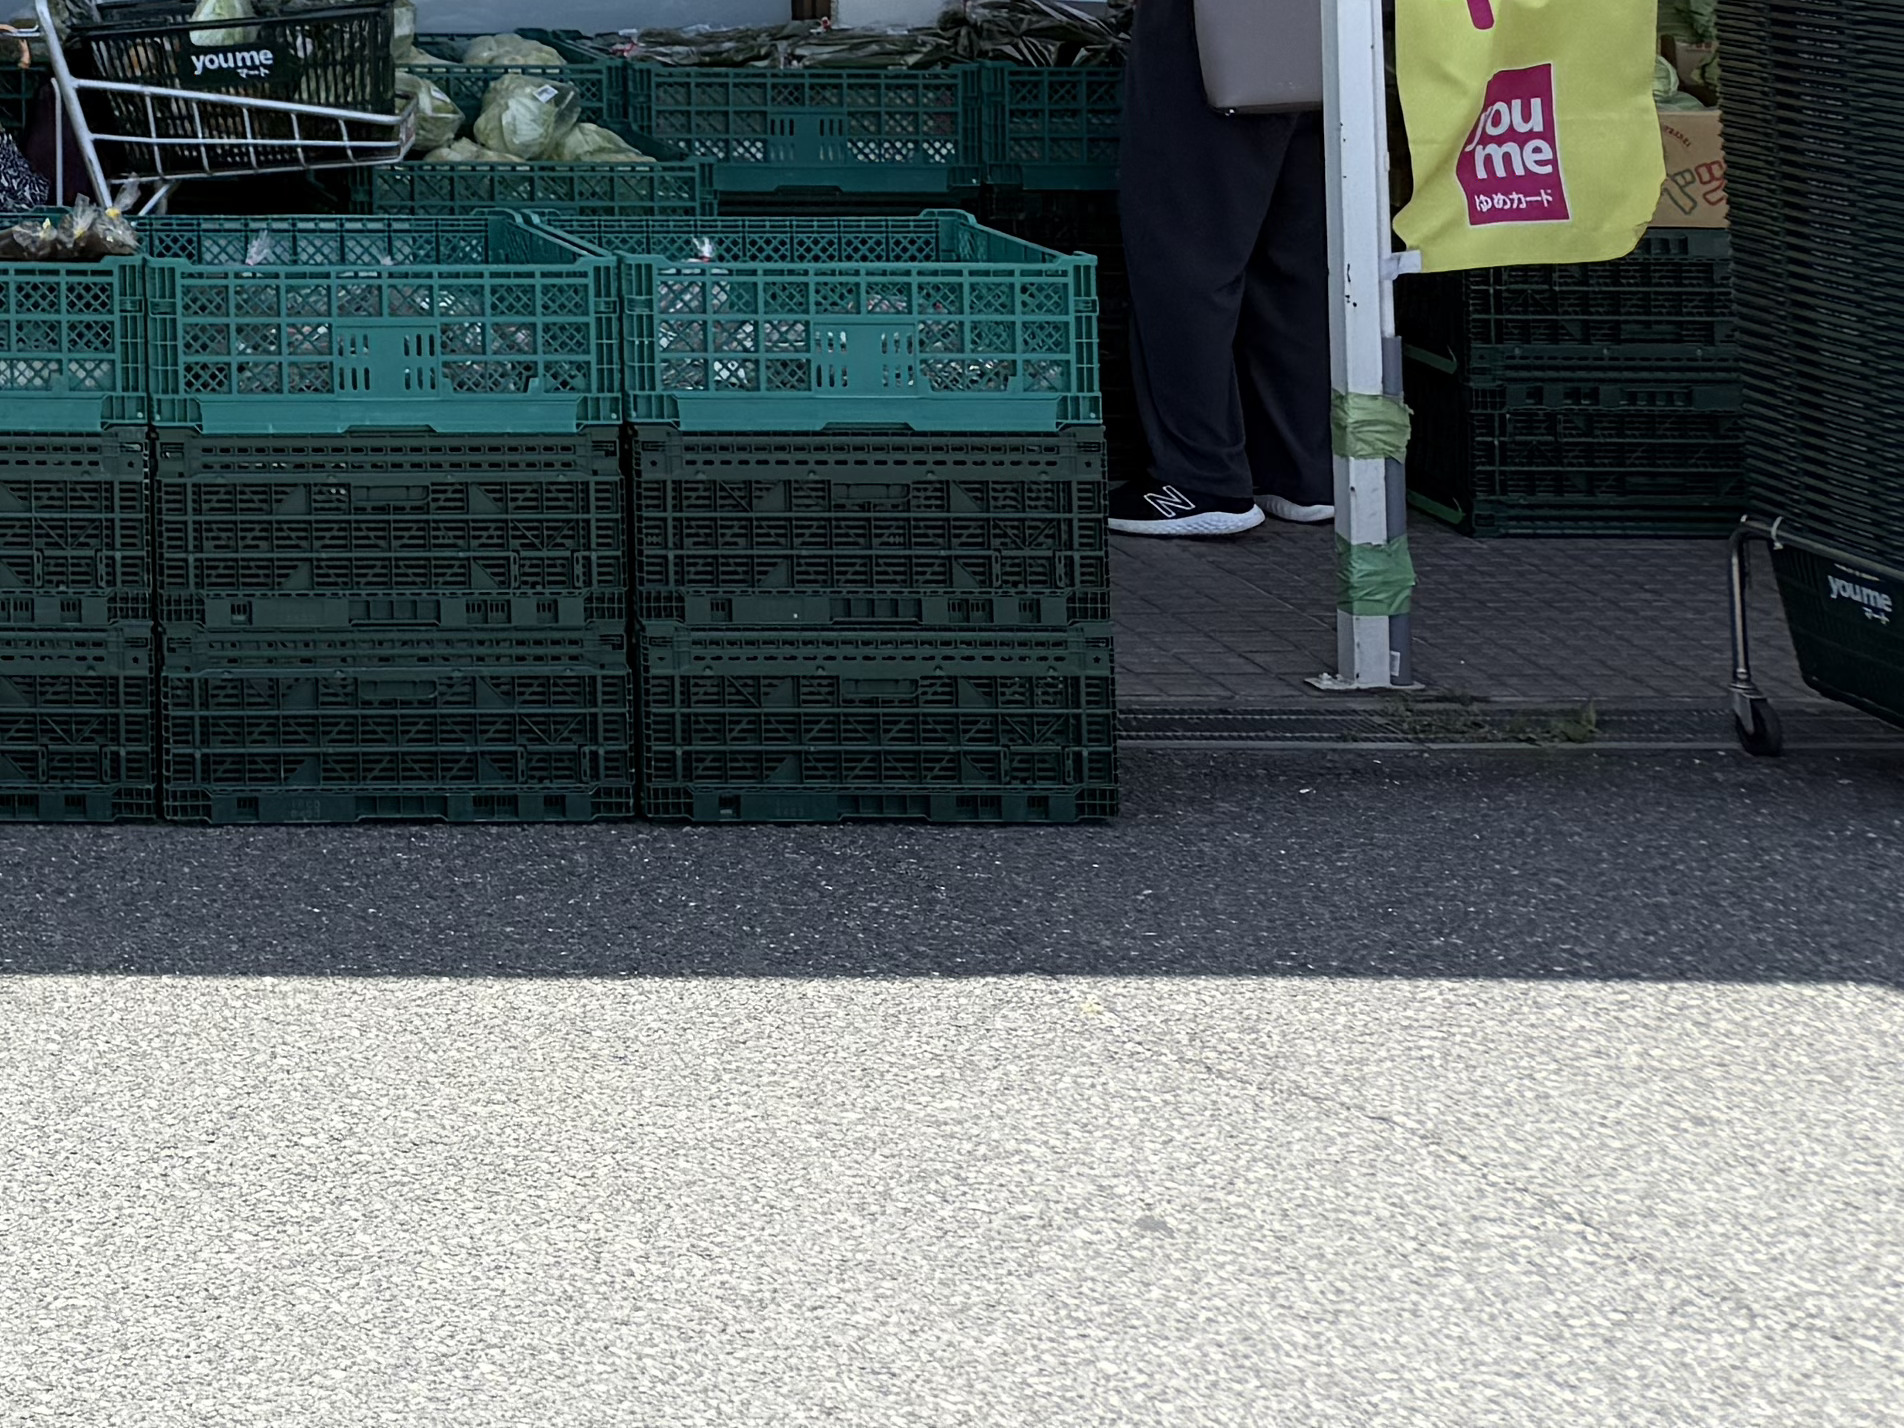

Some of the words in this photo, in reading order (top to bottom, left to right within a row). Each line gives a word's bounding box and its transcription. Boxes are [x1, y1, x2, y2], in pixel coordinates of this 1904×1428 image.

[236, 66, 270, 79] マート
[1474, 138, 1554, 180] me
[1474, 190, 1553, 213] ゆめカード
